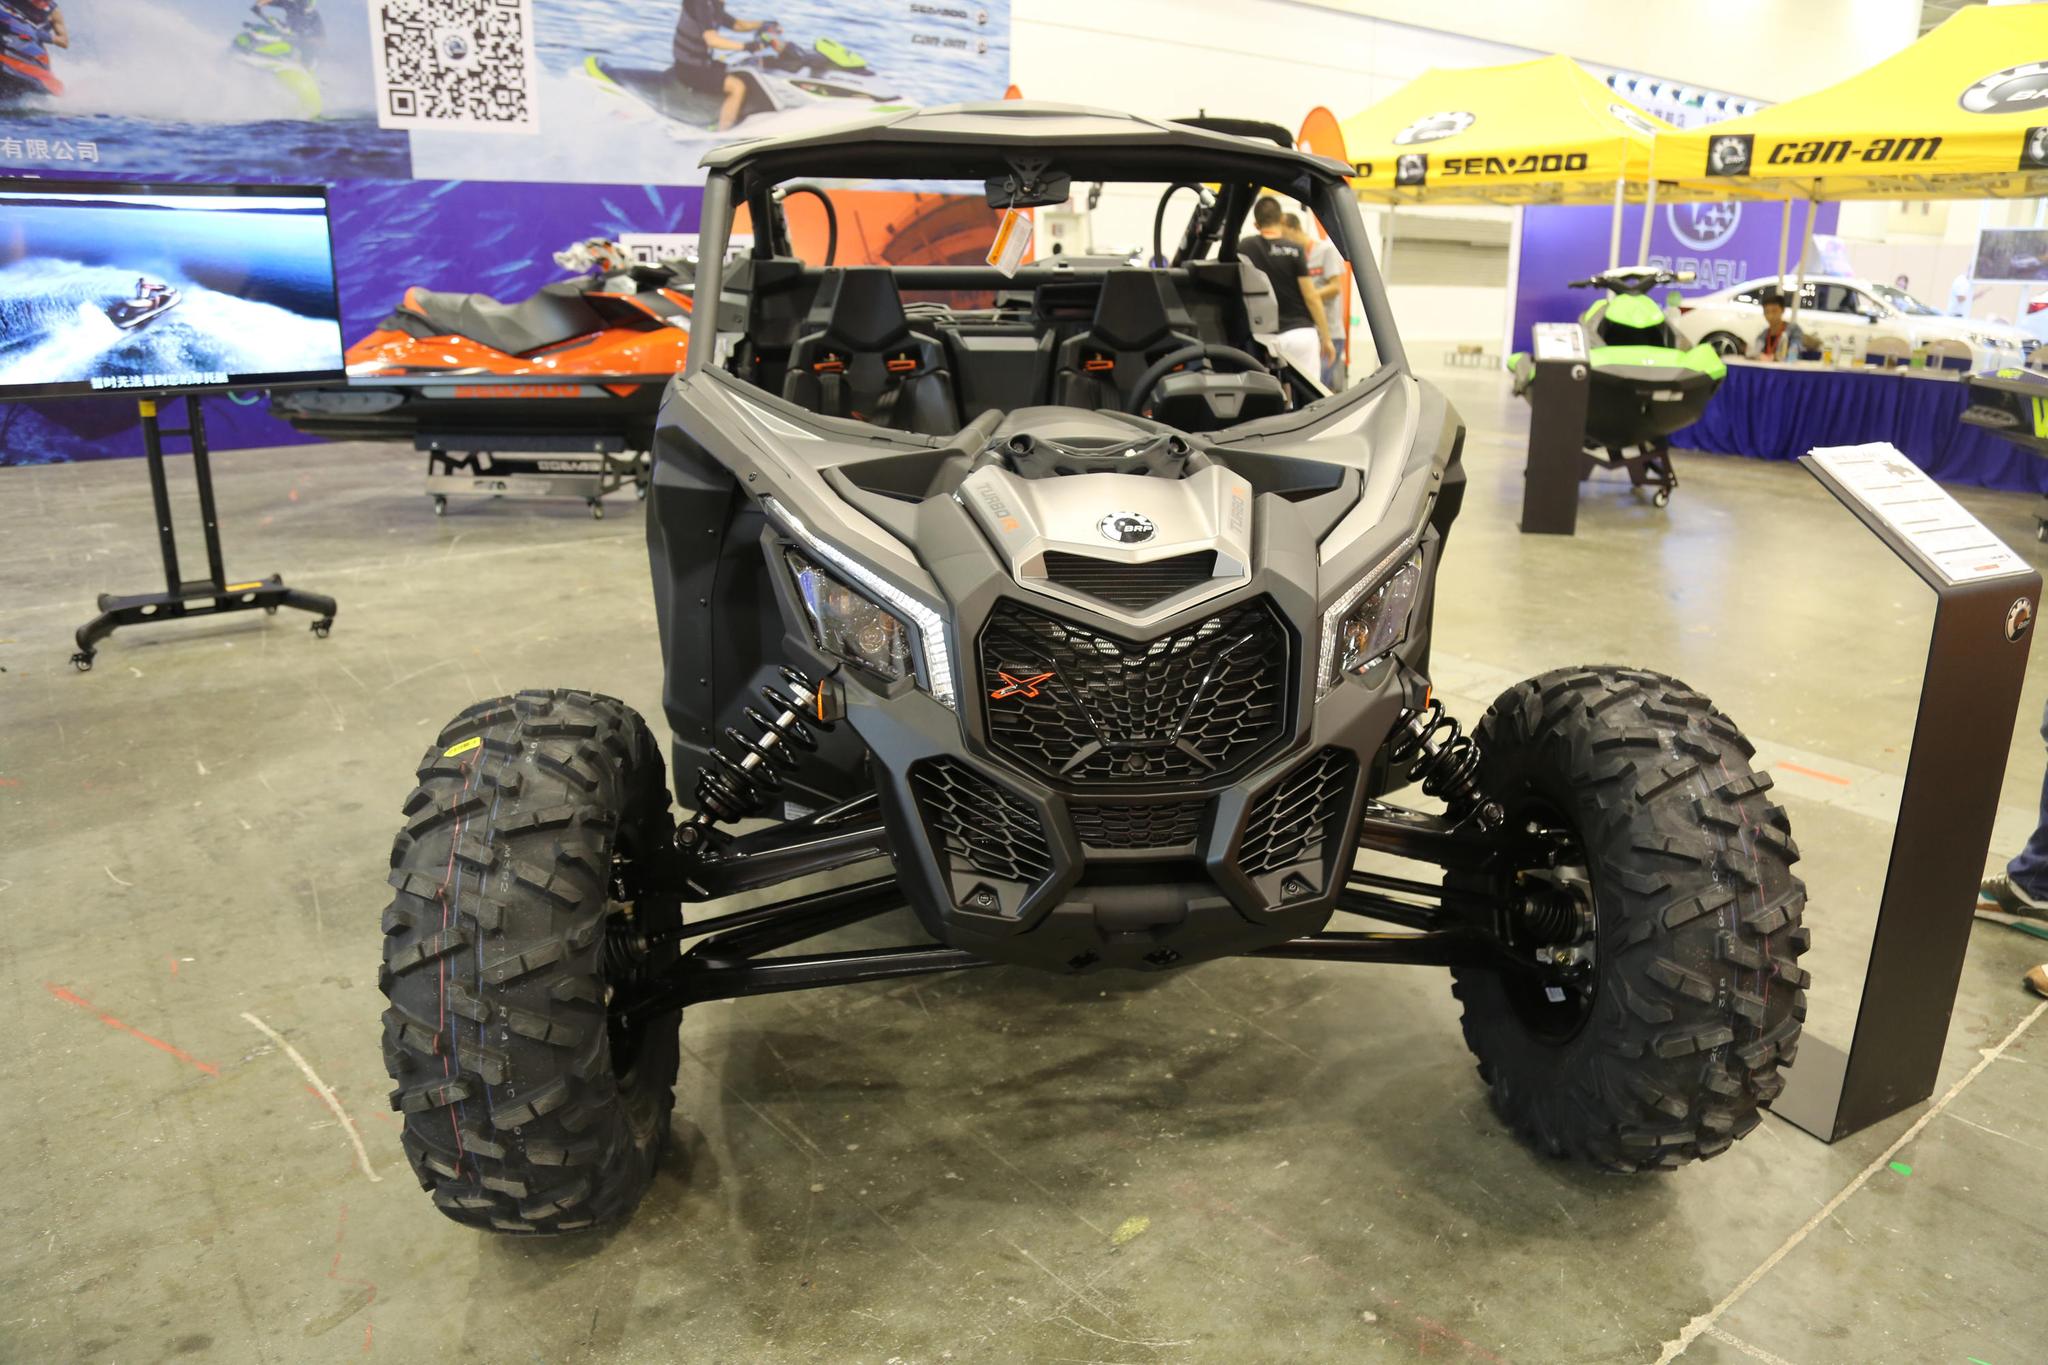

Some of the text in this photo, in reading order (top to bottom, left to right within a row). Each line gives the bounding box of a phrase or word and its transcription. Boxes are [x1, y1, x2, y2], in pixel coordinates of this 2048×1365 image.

[0, 137, 99, 162] 有限公司
[977, 482, 1009, 519] TURBO
